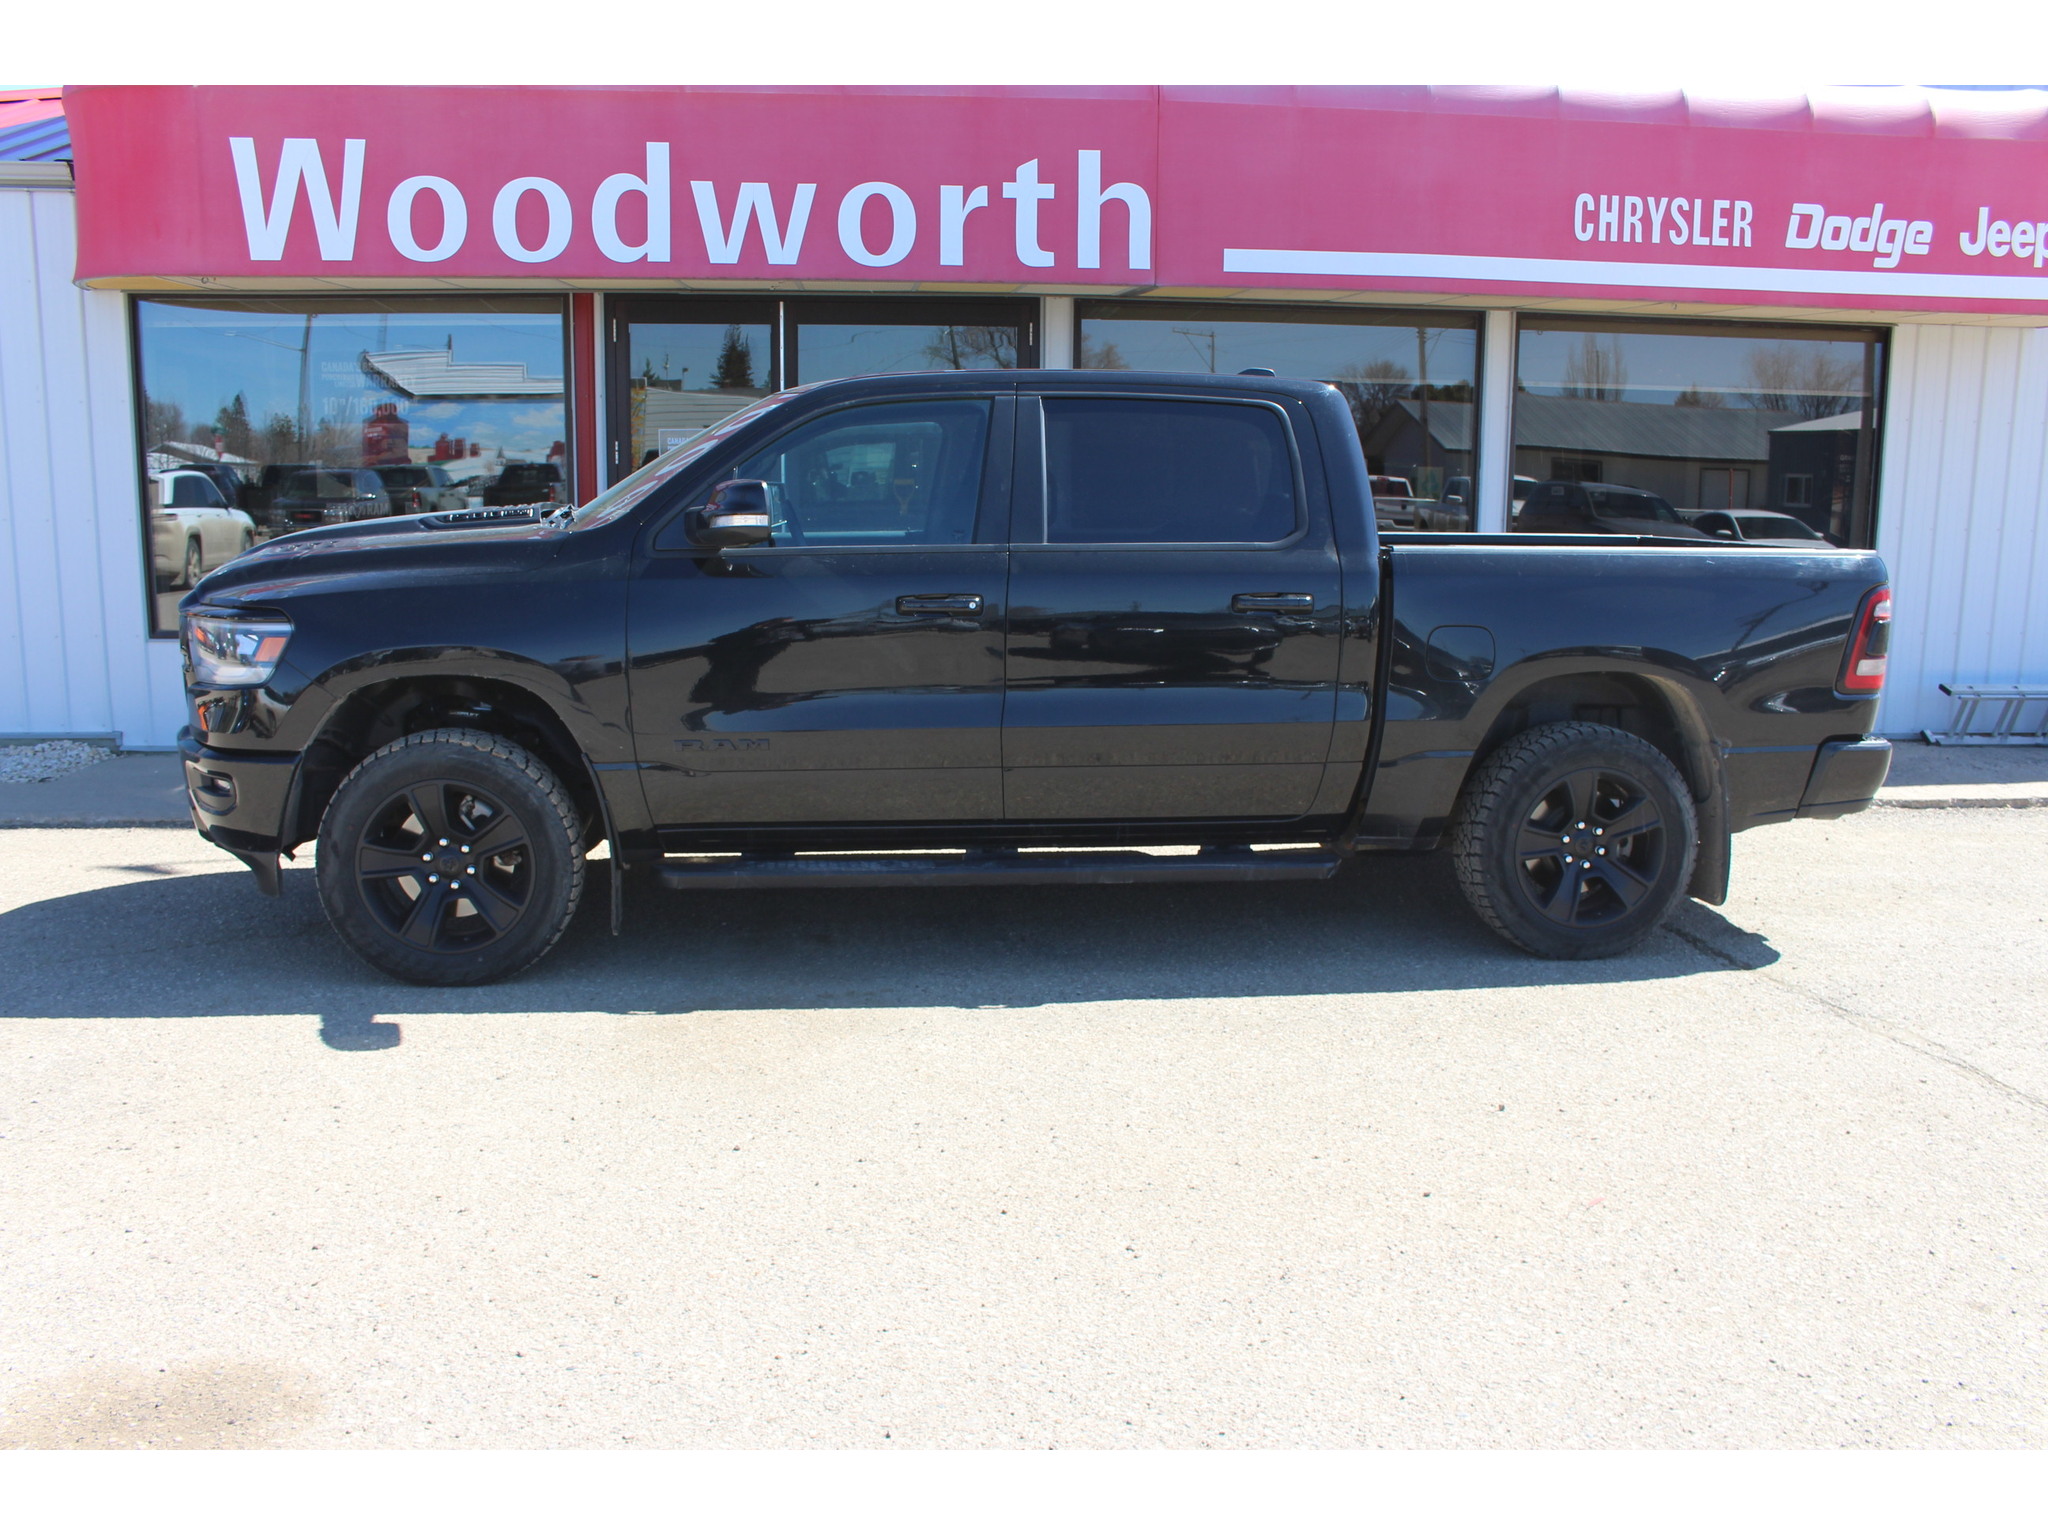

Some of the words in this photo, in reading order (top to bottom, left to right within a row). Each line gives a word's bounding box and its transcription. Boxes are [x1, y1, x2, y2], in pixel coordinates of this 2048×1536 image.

[229, 137, 1152, 270] Woodworth
[1574, 192, 1753, 248] CHRYSLER
[1785, 202, 1934, 269] Dodge
[673, 738, 770, 752] RAM
